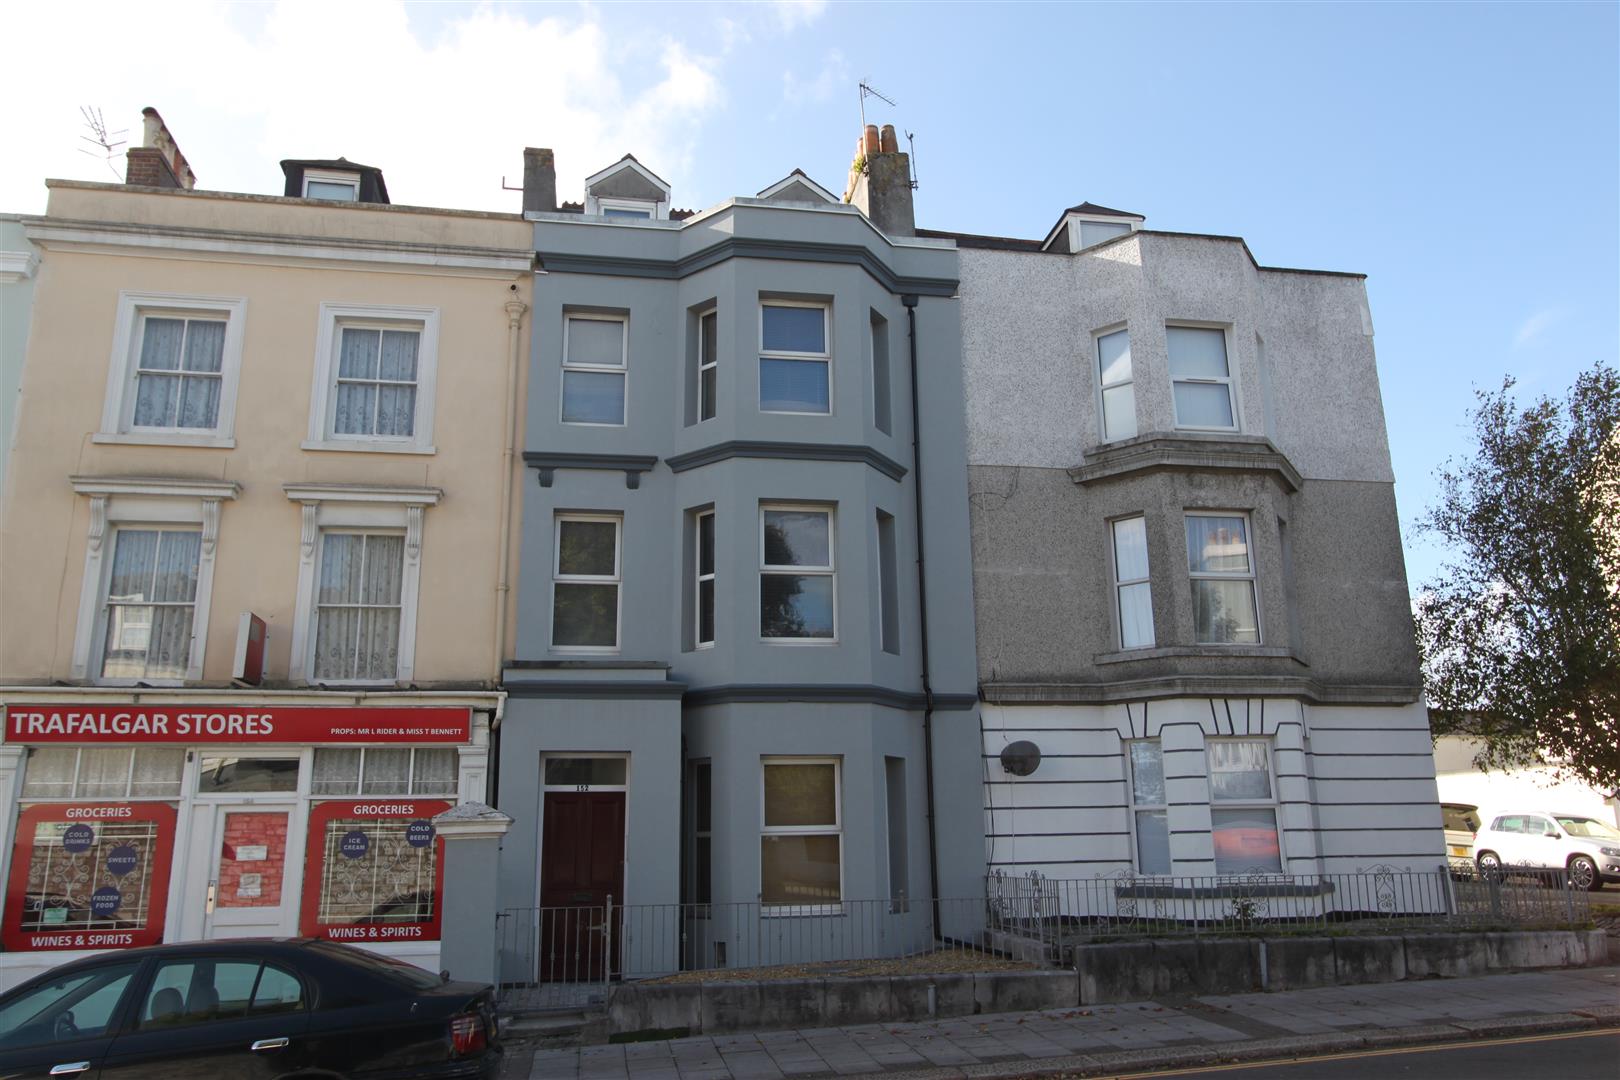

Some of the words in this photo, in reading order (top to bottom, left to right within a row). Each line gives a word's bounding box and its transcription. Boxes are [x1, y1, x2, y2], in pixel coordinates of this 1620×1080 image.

[11, 713, 168, 734] TRAFALGAR
[176, 714, 274, 734] STORES
[576, 784, 589, 792] 152
[66, 807, 132, 817] GROCERIES
[353, 805, 414, 815] GROCERIES
[328, 927, 366, 938] WINES
[368, 927, 378, 937] &
[380, 926, 422, 937] SPIRITS
[31, 935, 72, 947] WINES
[74, 934, 85, 946] &
[87, 934, 133, 945] SPIRITS
